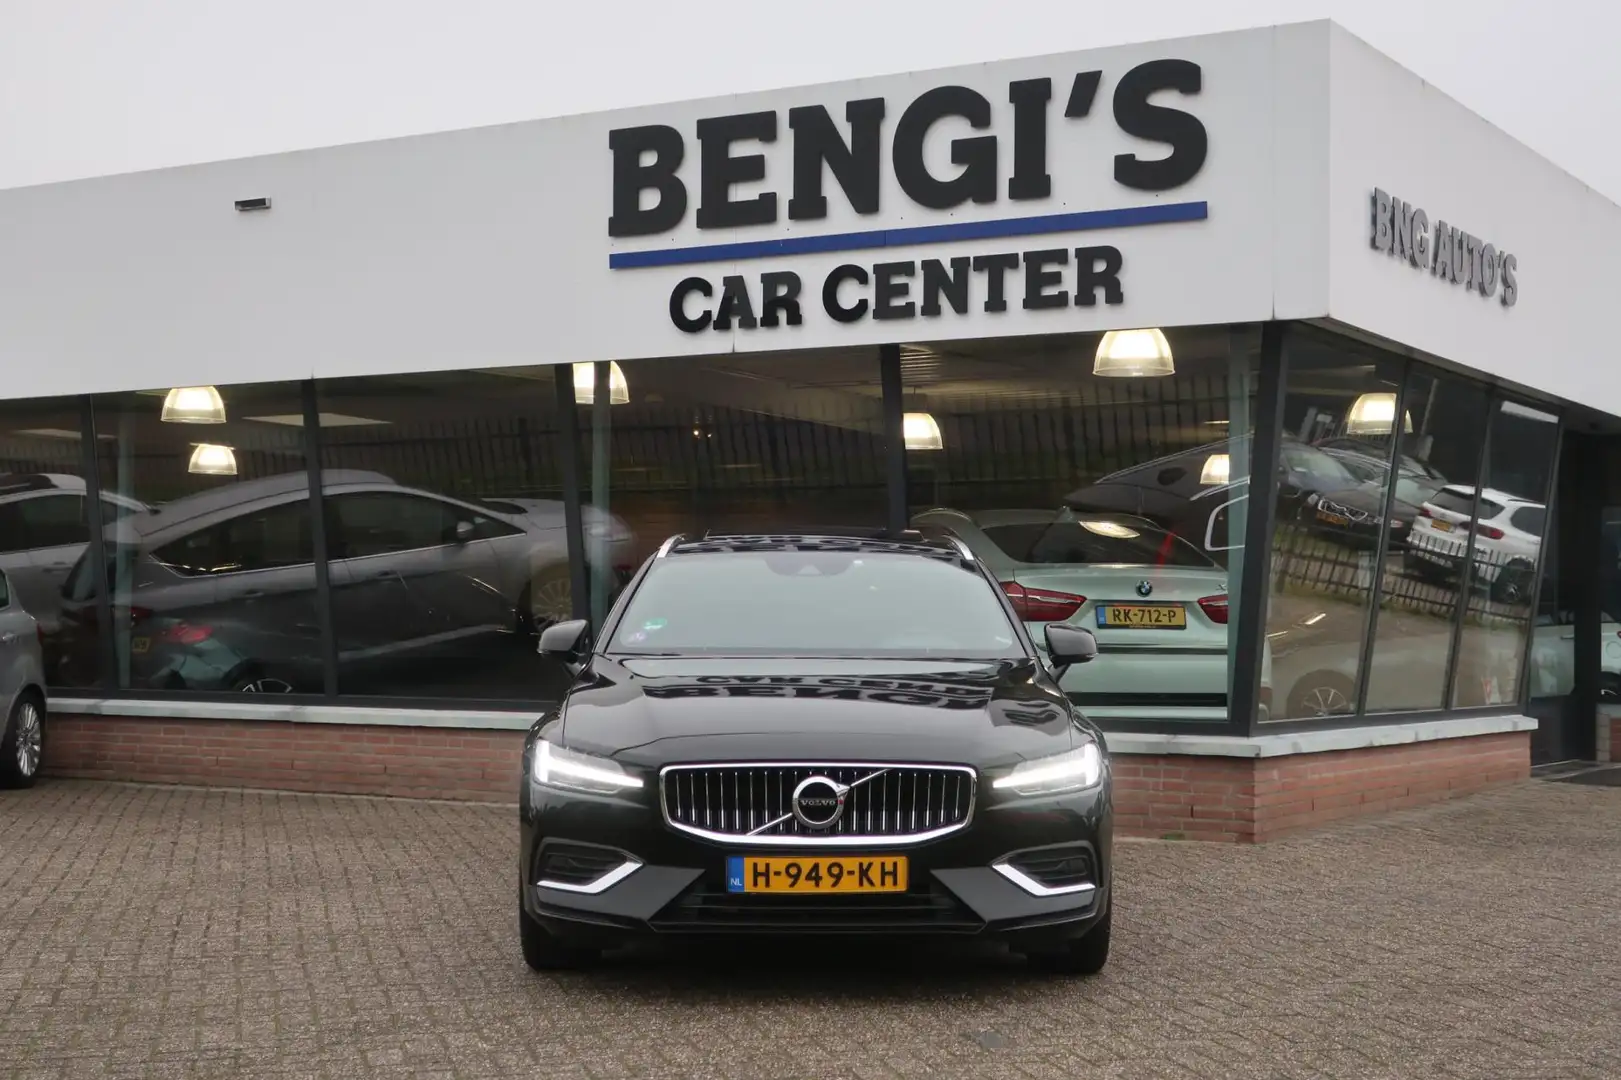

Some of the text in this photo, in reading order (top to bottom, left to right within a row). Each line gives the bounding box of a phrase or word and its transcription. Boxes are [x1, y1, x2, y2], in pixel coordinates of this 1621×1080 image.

[608, 58, 1208, 237] BENGI'S
[669, 245, 1124, 333] CAR CENTER
[1370, 187, 1518, 307] BNG AUTO'S
[1111, 608, 1177, 623] RK-712-P
[730, 861, 898, 888] NL H-949-KH
